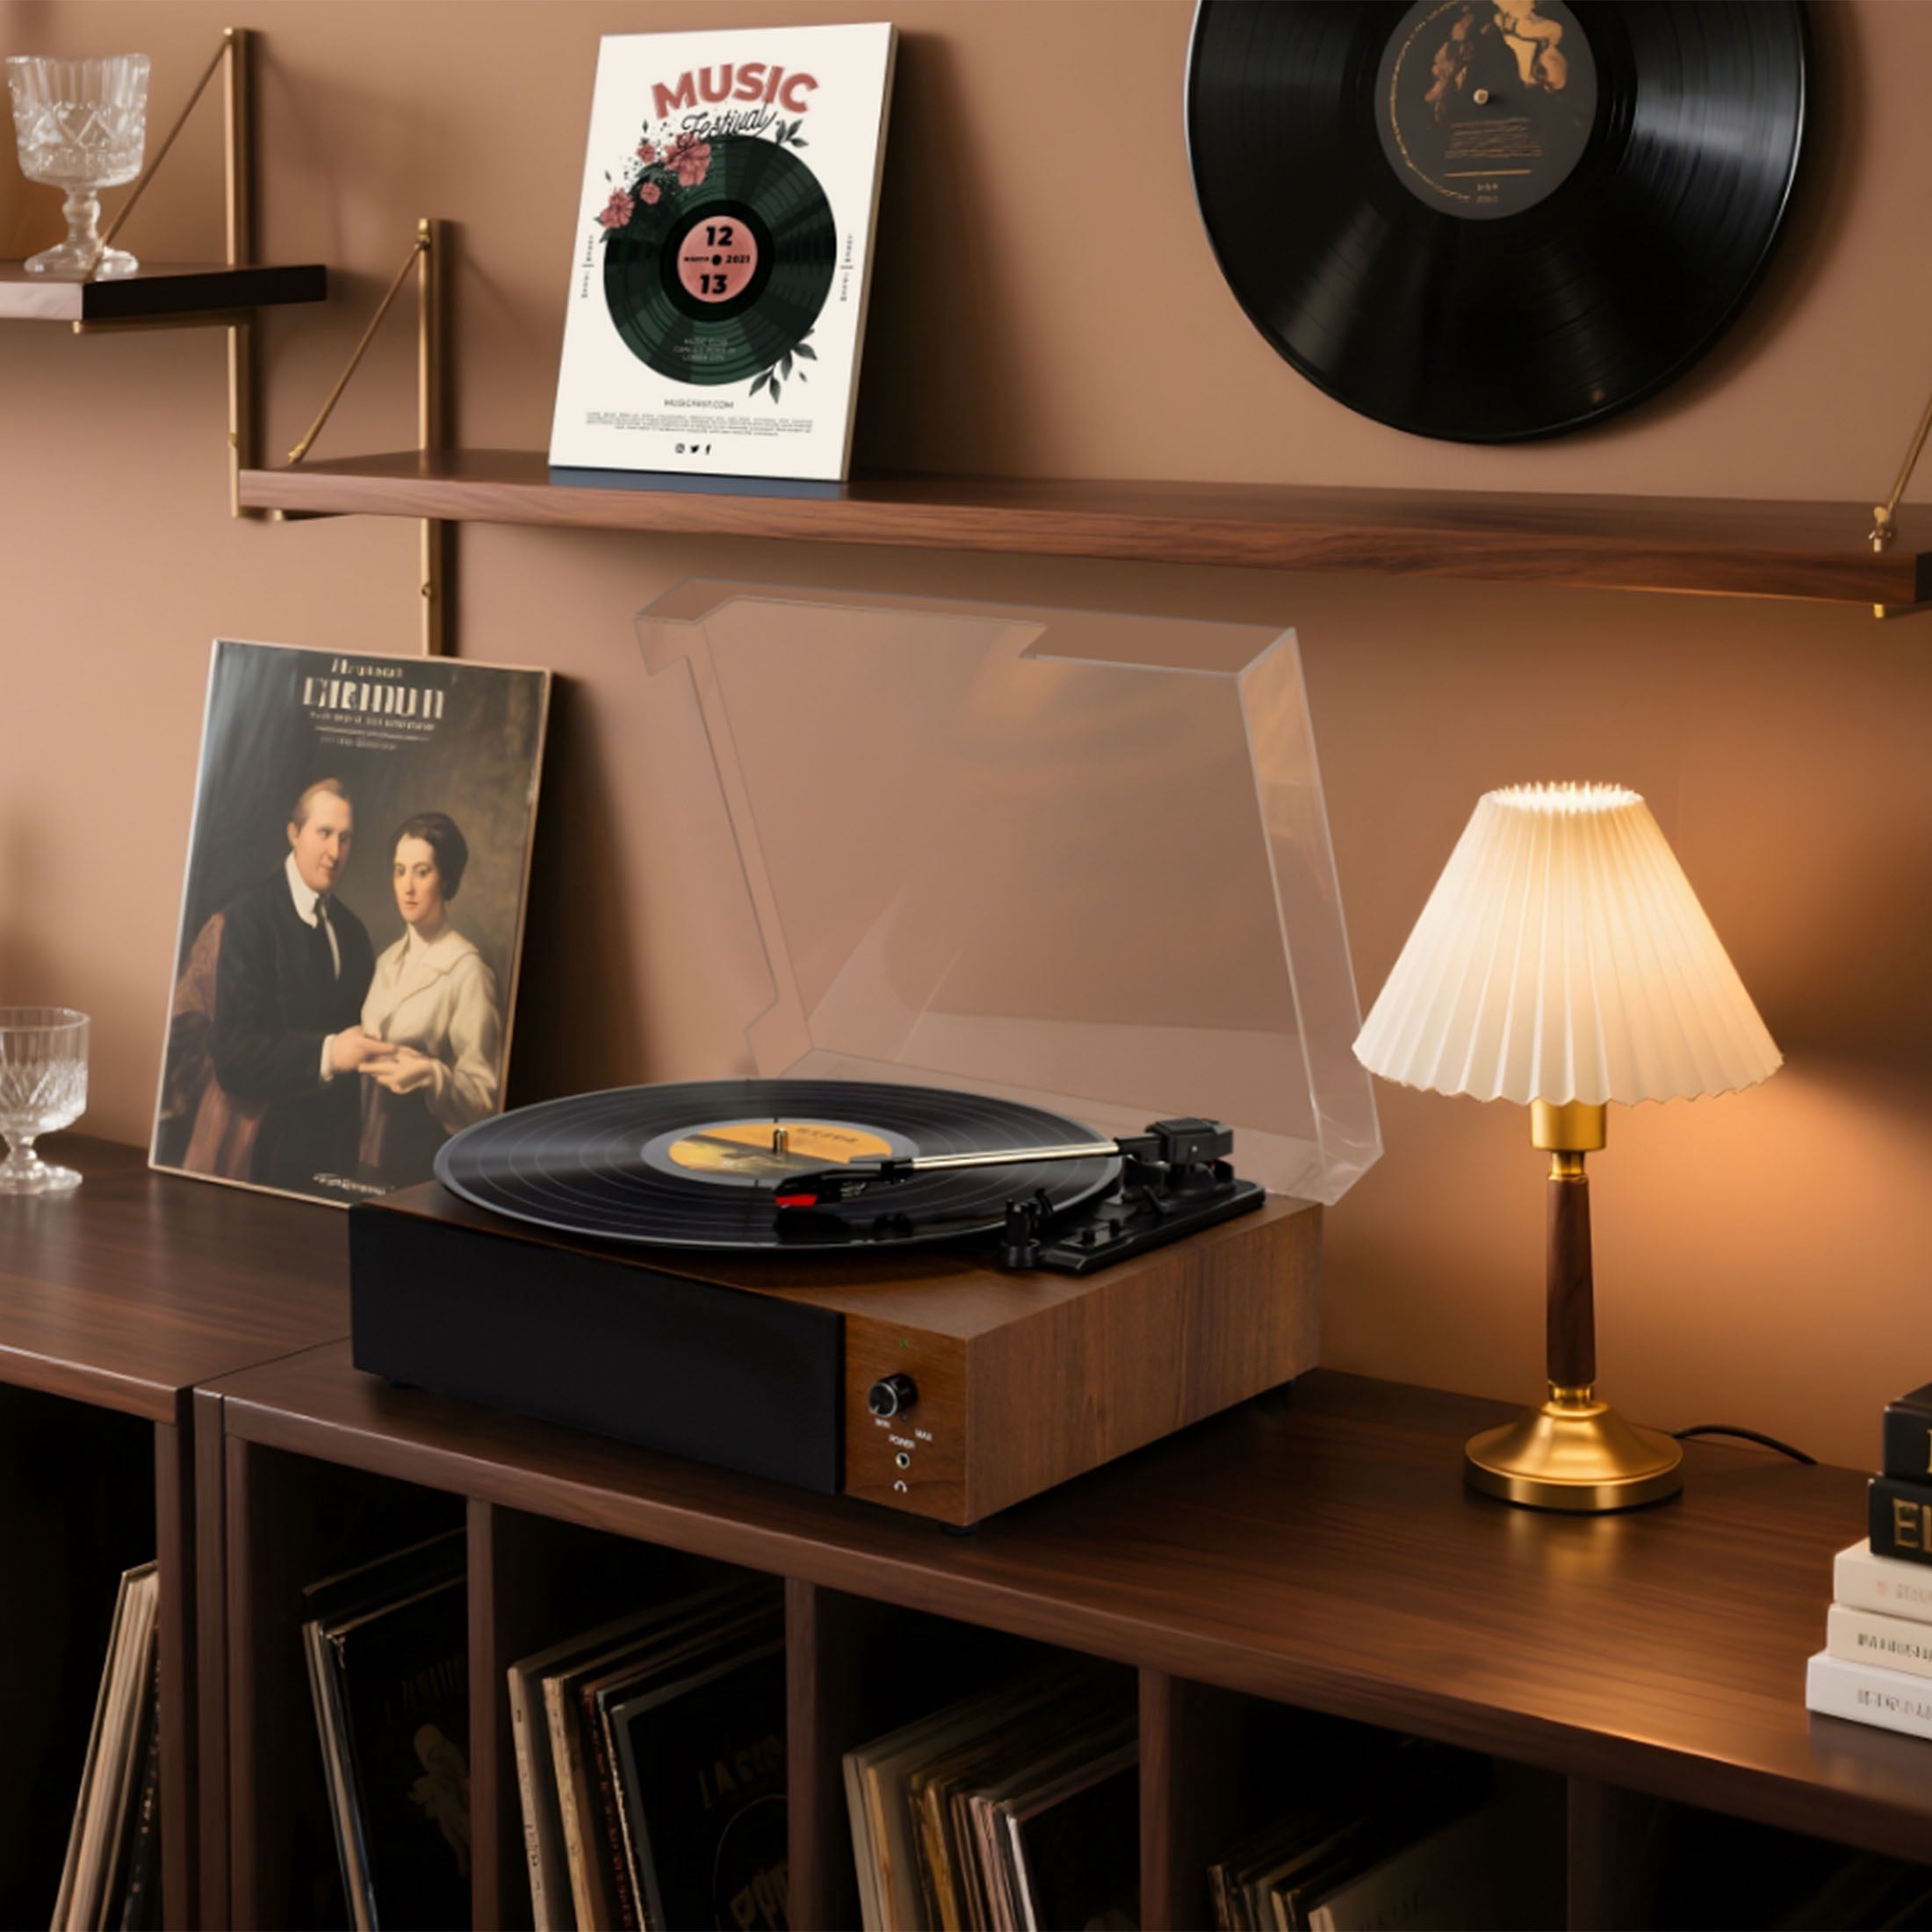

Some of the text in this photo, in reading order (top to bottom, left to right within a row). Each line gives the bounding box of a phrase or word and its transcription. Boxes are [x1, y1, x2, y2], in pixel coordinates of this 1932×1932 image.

[652, 62, 818, 119] MUSIC
[681, 102, 778, 137] Festival
[706, 226, 733, 247] 12
[725, 255, 750, 263] 2021
[700, 274, 727, 295] 13
